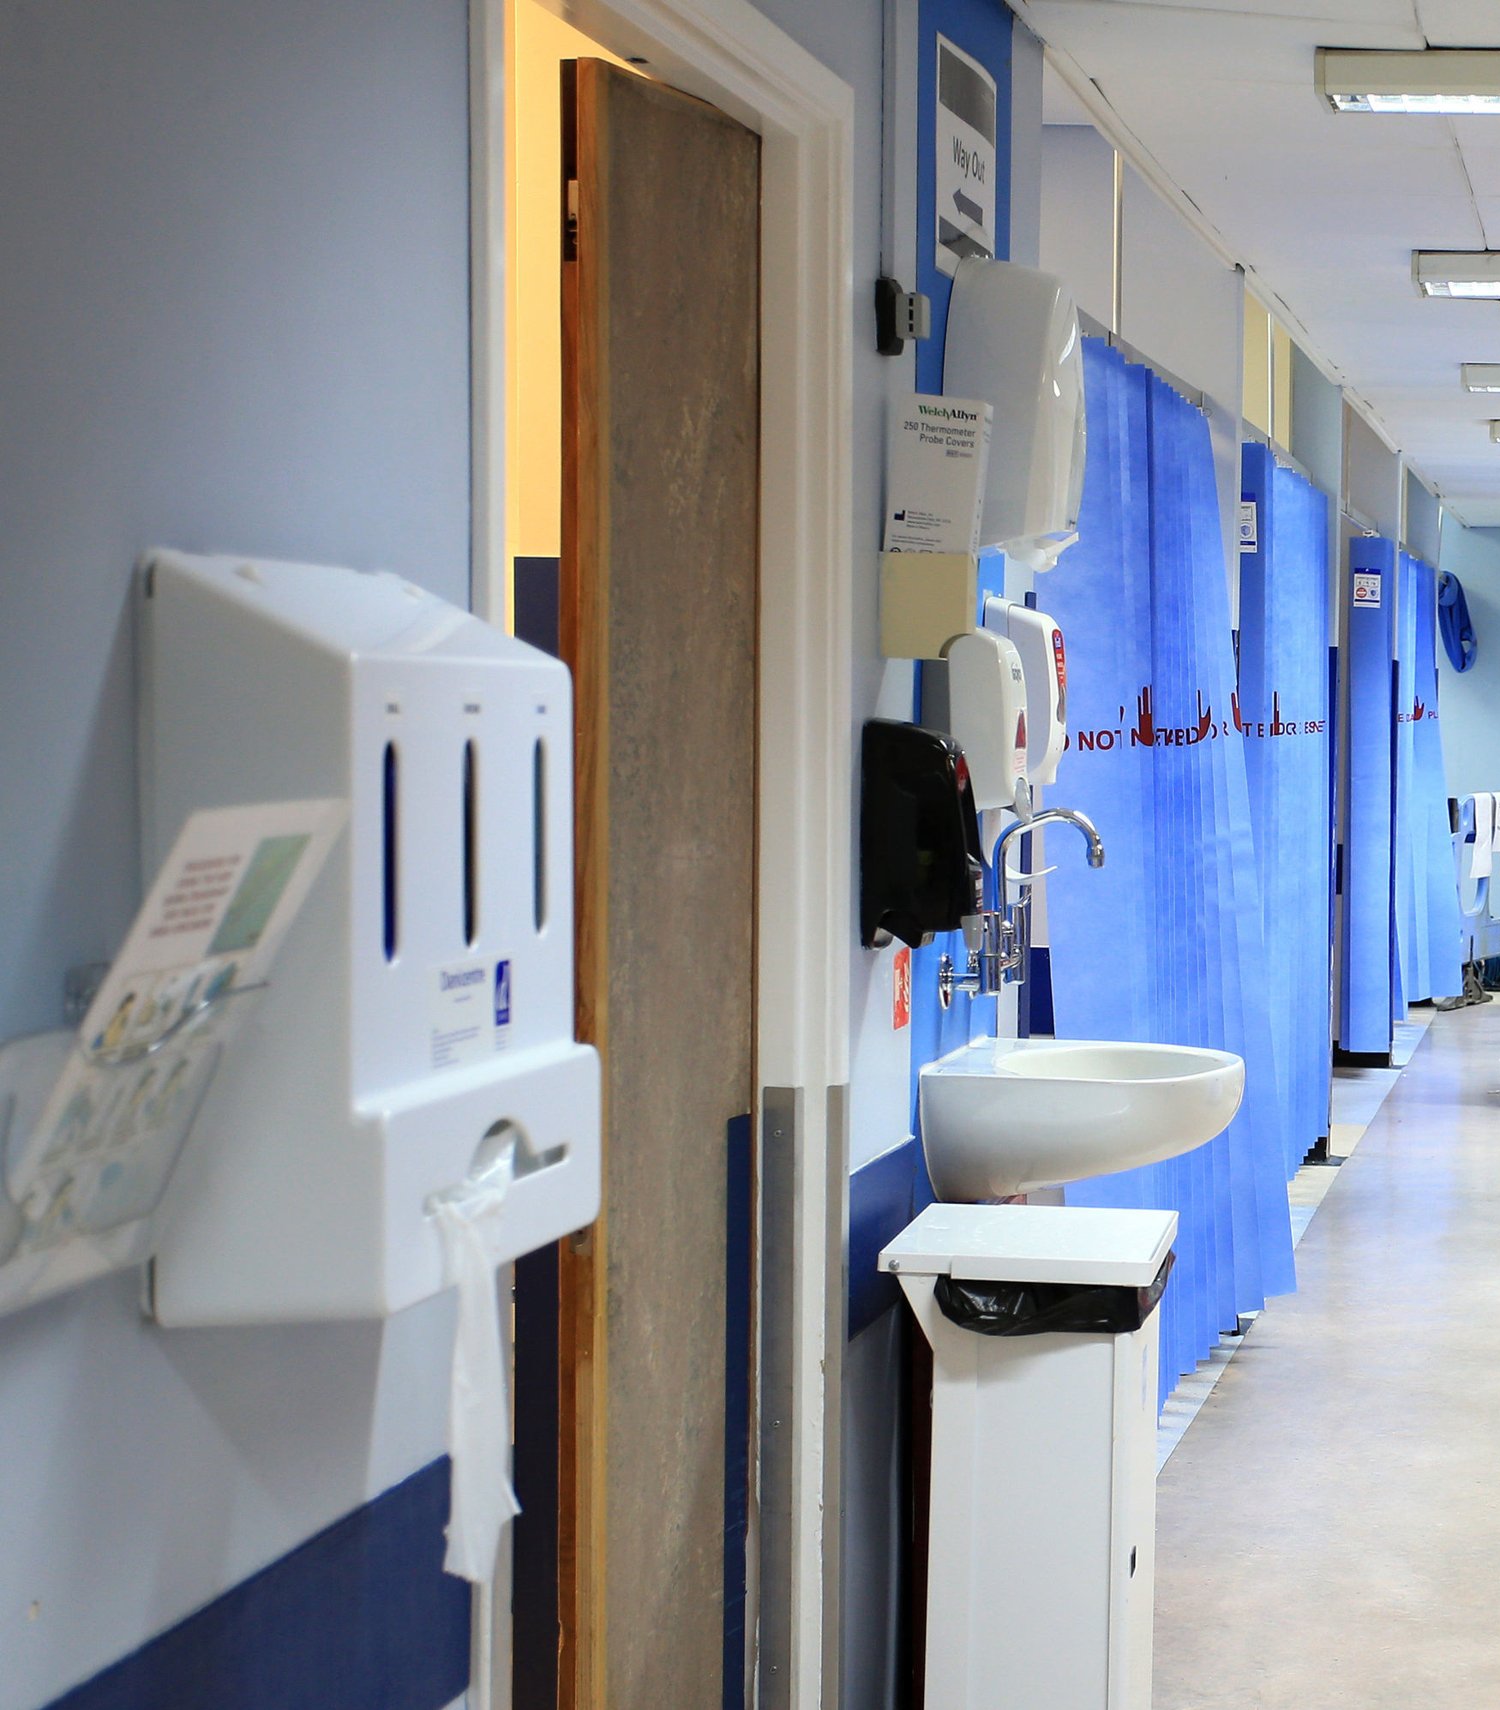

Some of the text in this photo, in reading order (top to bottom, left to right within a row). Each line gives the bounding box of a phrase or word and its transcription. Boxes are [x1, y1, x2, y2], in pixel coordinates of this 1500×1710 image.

[953, 136, 985, 184] Way Out
[904, 421, 919, 431] 250
[921, 423, 976, 438] Thermometer
[920, 433, 974, 448] Probe Covers
